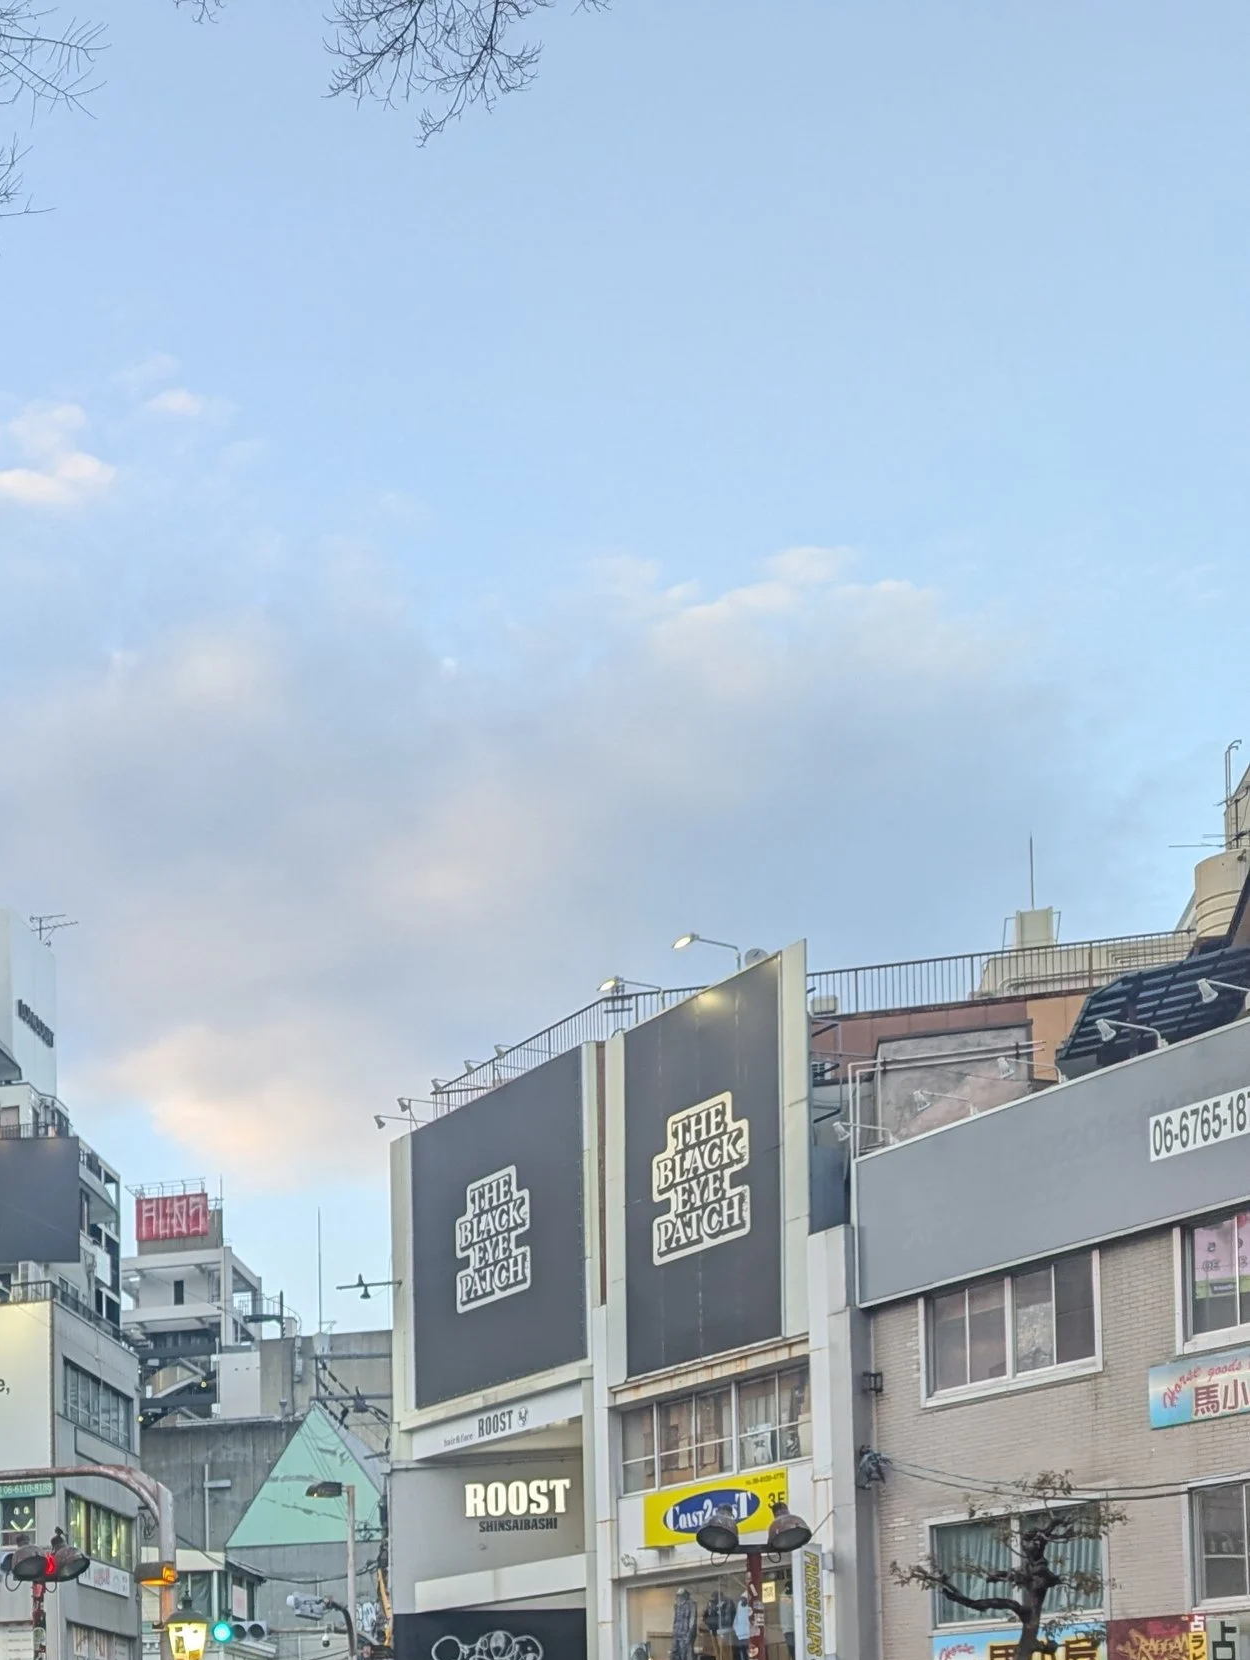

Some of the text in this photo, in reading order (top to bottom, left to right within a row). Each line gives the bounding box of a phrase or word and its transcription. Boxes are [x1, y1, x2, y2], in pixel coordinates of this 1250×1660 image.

[673, 1103, 724, 1150] THE
[658, 1129, 740, 1190] BLACK
[471, 1174, 510, 1214] THE
[675, 1170, 723, 1215] EYE
[460, 1198, 523, 1248] BLACK
[658, 1195, 741, 1253] PATCH
[473, 1232, 510, 1269] EYE
[461, 1254, 524, 1301] PATCH
[1206, 1359, 1242, 1382] goods
[477, 1409, 513, 1438] ROOST
[464, 1478, 571, 1518] ROOST
[479, 1517, 558, 1533] SHINSAIBASHI
[804, 1550, 823, 1657] FRESH CAPS
